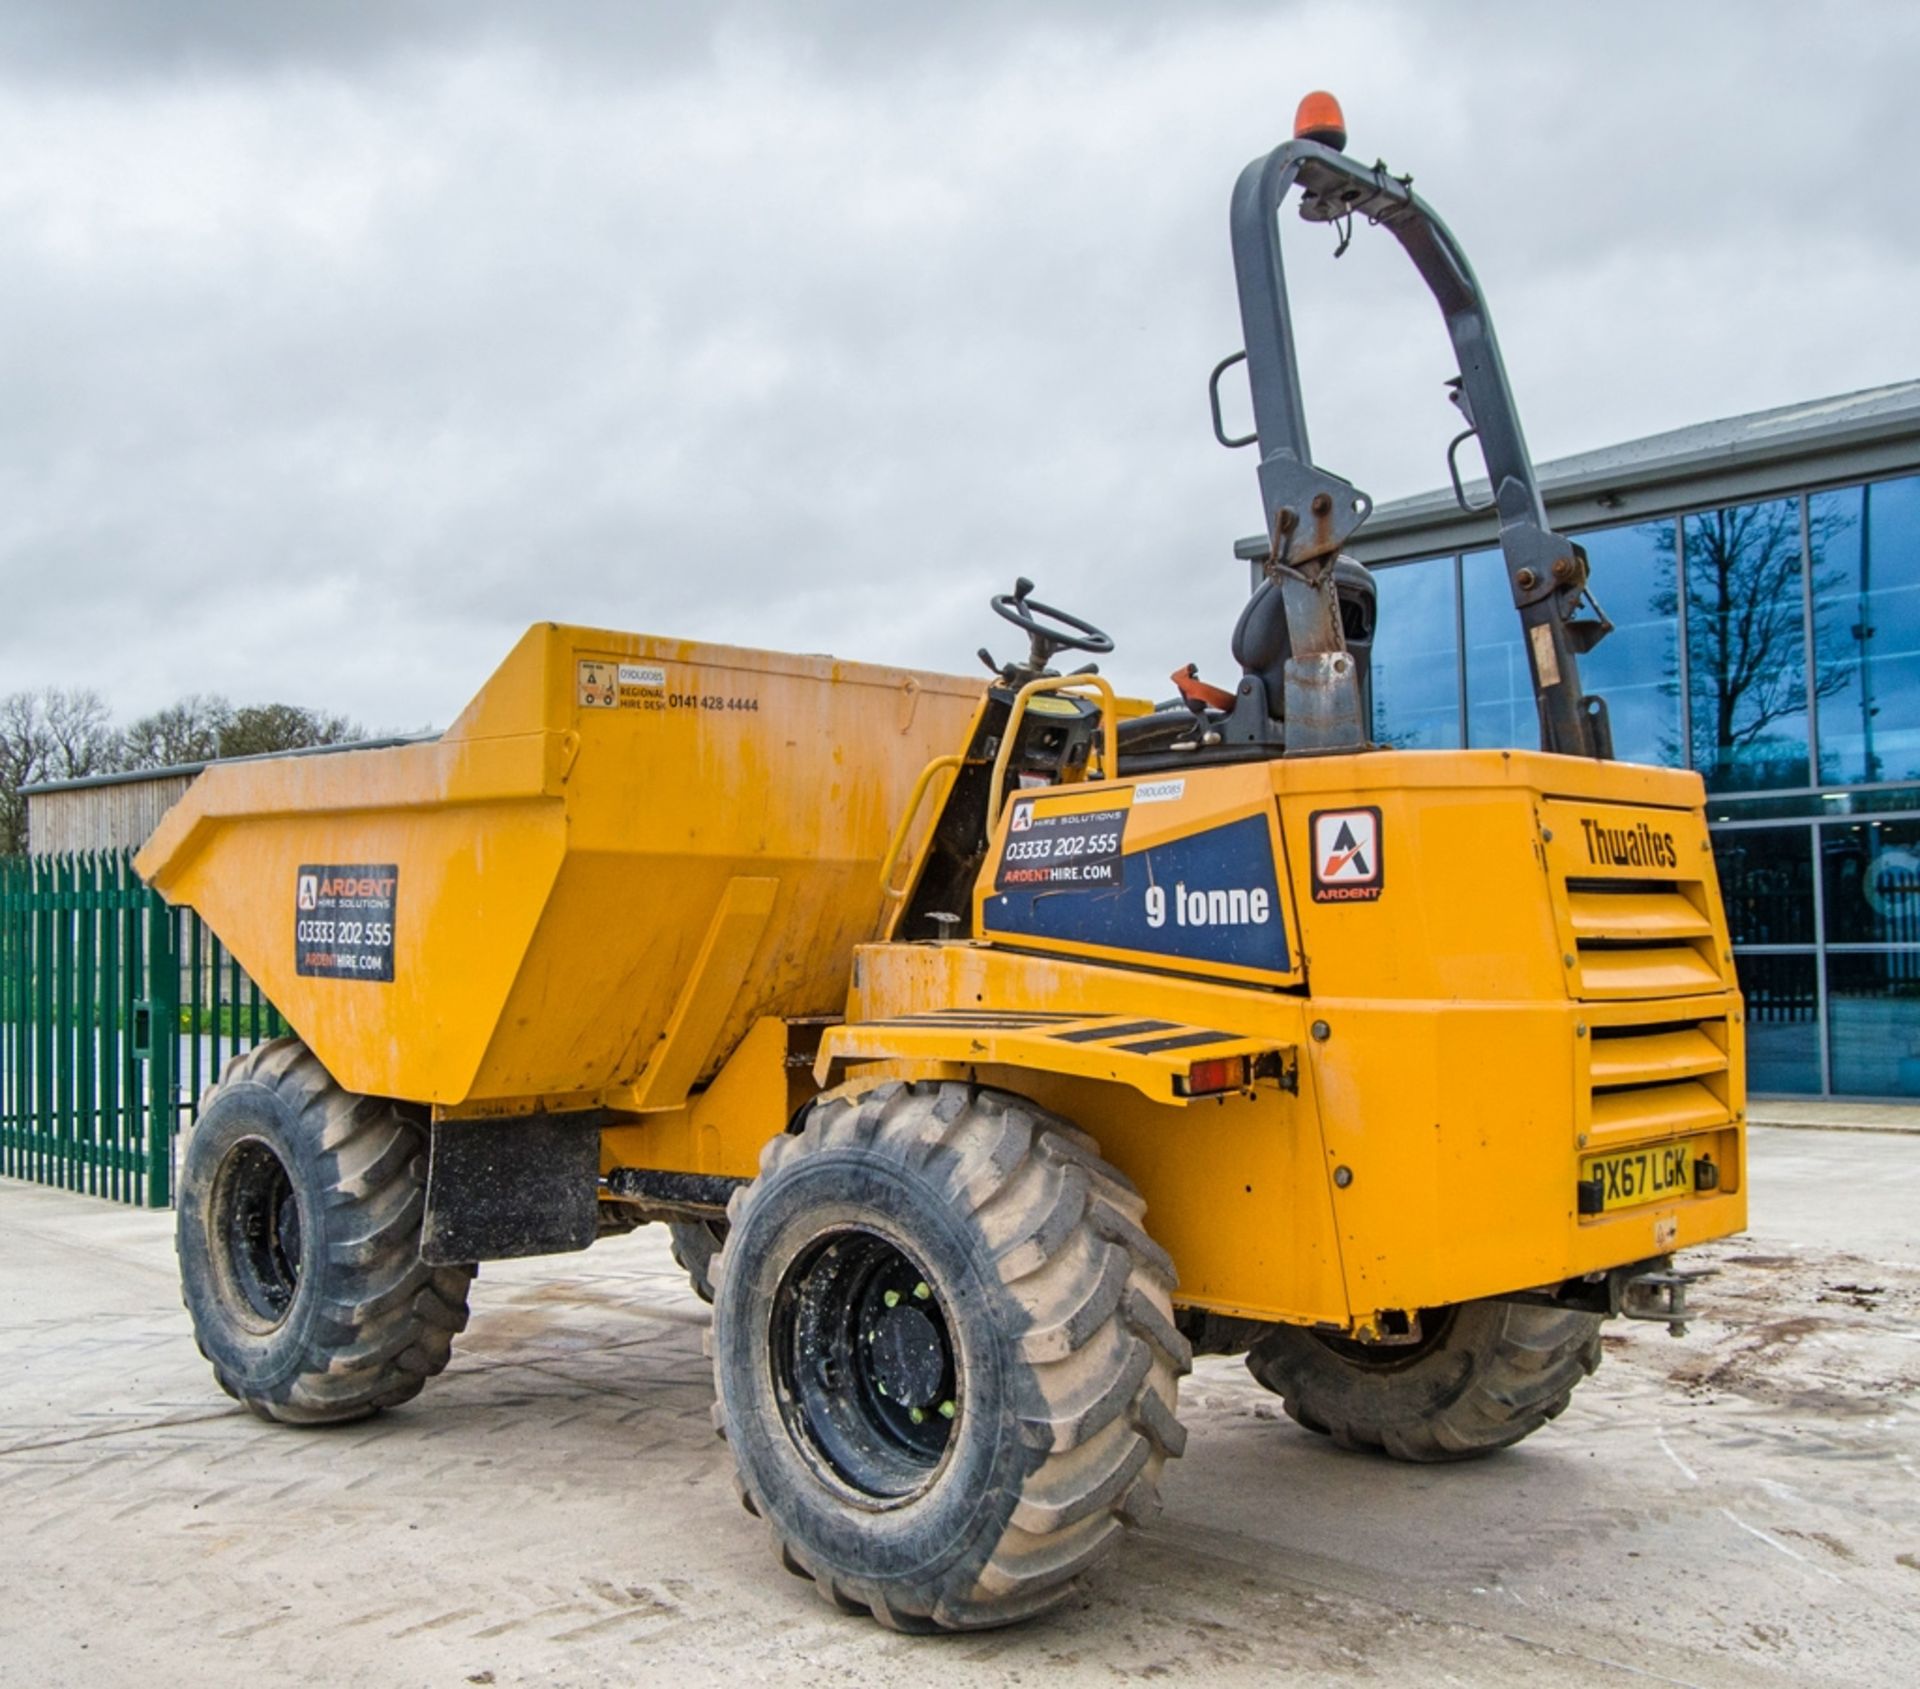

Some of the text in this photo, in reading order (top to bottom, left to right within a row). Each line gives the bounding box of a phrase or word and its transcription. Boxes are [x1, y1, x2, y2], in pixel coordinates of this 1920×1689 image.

[620, 688, 664, 698] REGIONAL
[620, 700, 665, 711] HIRE DESK
[669, 694, 758, 712] 0141 428 4444
[1034, 811, 1122, 826] HIRE SOLUTIONS
[1006, 833, 1118, 860] 03333 202 555
[1580, 818, 1677, 868] Thwaites
[1004, 865, 1112, 882] ARDENTHIRE.COM
[320, 878, 395, 897] ARDENT
[1316, 887, 1380, 900] ARDENT
[319, 899, 390, 909] HIRE SOLUTIONS
[1145, 881, 1270, 928] 9 tonne
[298, 920, 391, 946] 03333 202 555
[304, 952, 382, 970] ARDENTHIRE.COM
[1652, 1148, 1687, 1191] LGK
